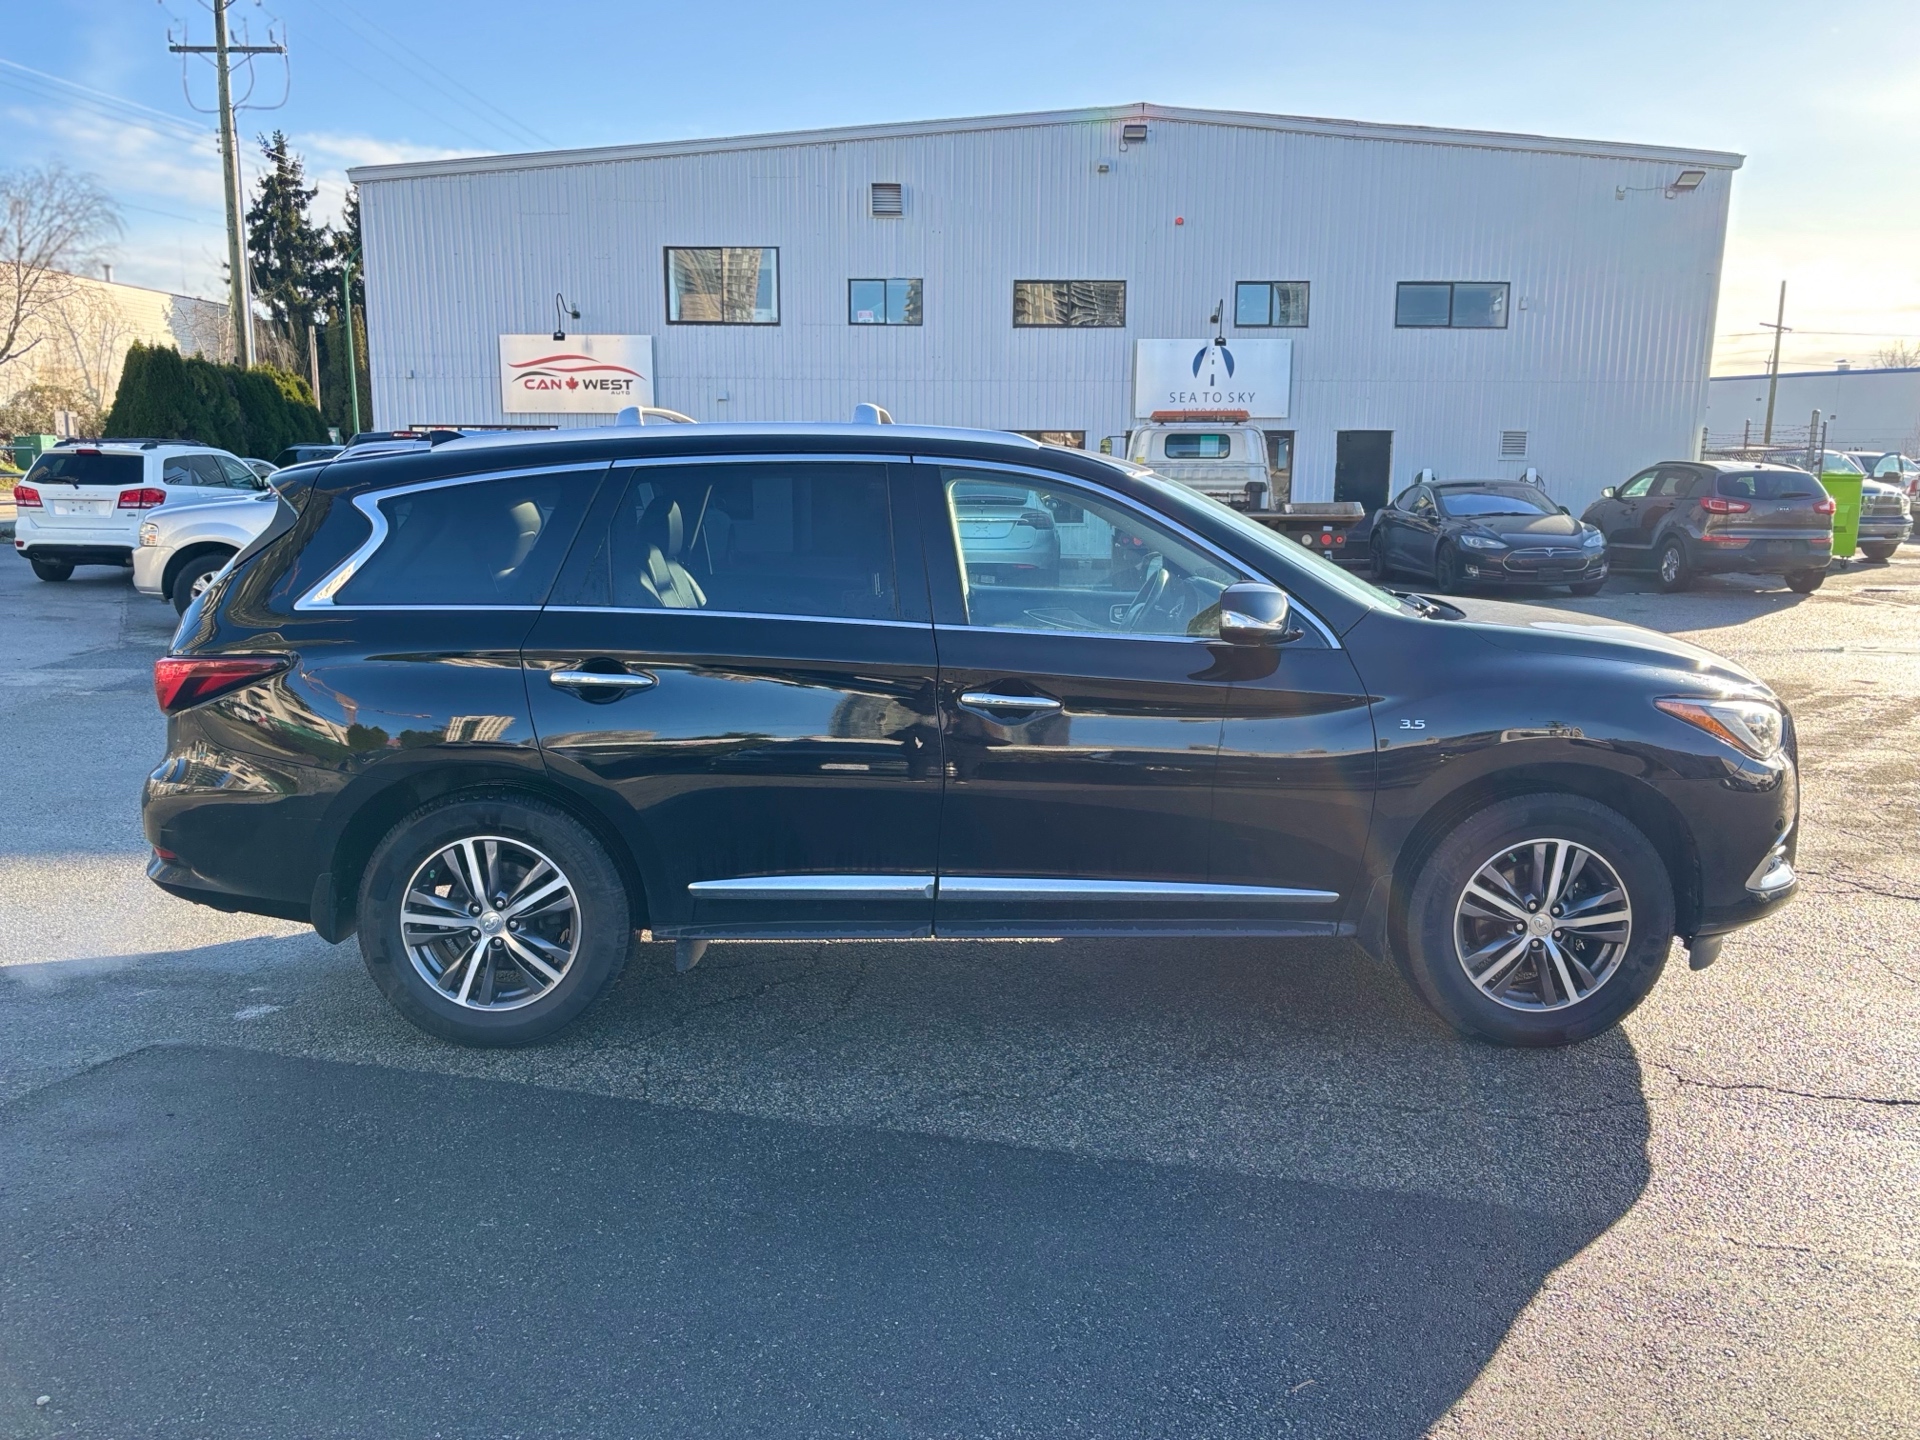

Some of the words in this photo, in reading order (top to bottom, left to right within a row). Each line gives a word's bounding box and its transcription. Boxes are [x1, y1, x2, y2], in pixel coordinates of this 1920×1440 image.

[524, 379, 562, 390] CAN
[583, 379, 633, 390] WEST
[1169, 391, 1197, 403] SEA
[1202, 391, 1222, 403] TO
[1227, 391, 1256, 403] SKY
[1399, 719, 1426, 729] 3.5
